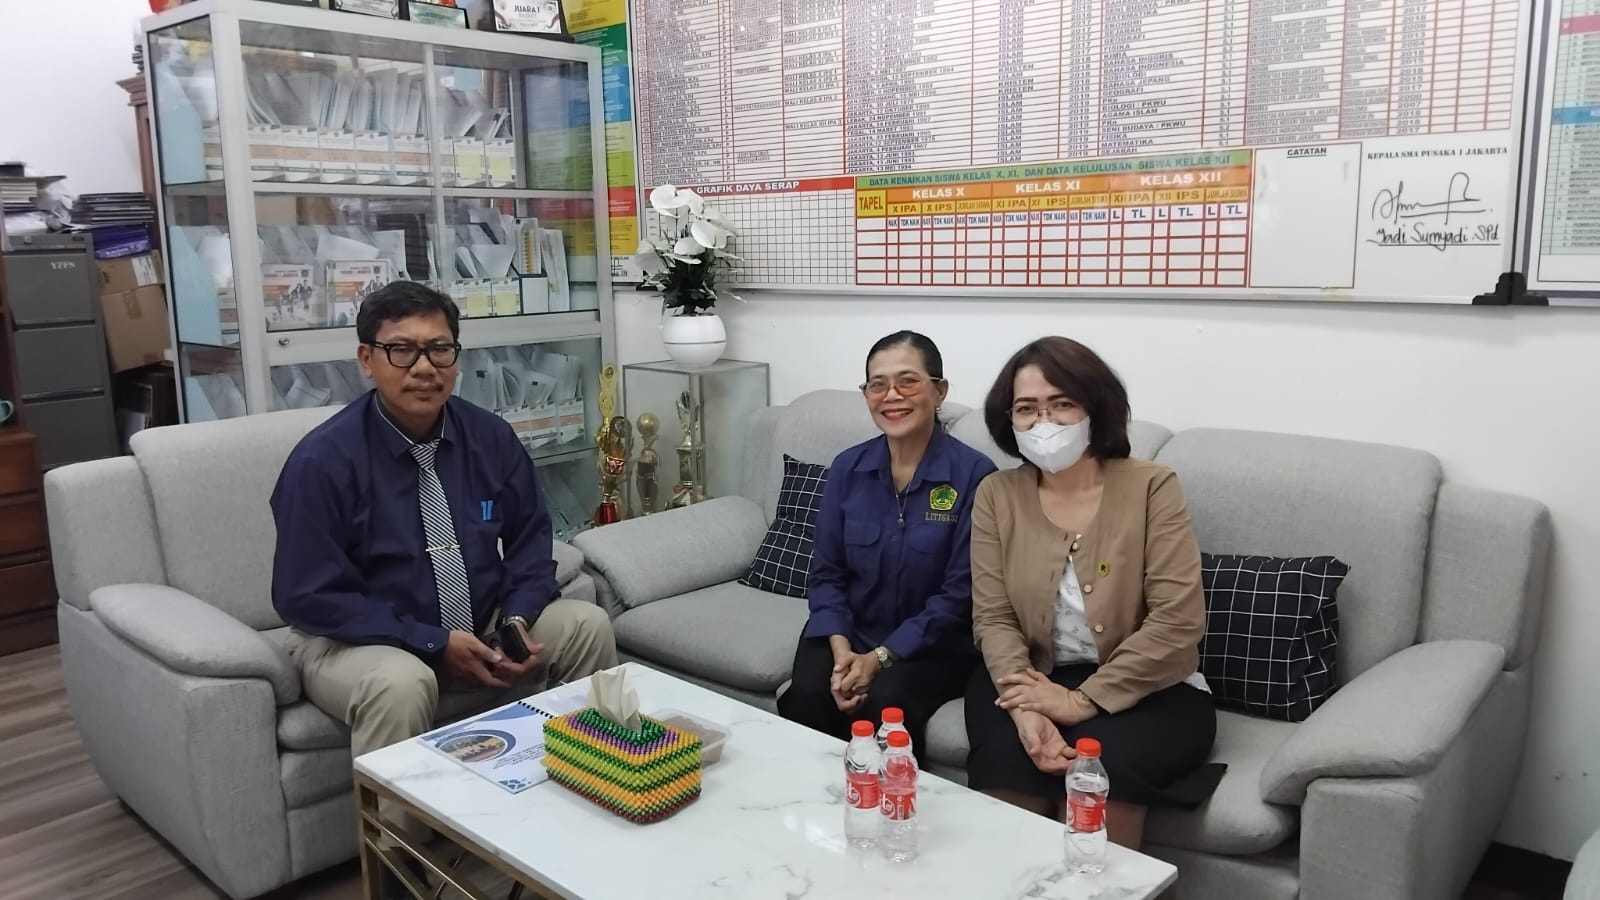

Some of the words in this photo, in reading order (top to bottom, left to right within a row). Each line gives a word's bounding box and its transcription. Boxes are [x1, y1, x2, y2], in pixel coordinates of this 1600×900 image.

[1102, 111, 1130, 119] AGAMA
[1133, 108, 1158, 116] ISLAM
[1101, 139, 1153, 148] MATEMATIKA
[1287, 147, 1327, 157] CATATAN
[1367, 151, 1399, 160] KEPALA
[1421, 150, 1456, 158] PUSAKA
[1465, 147, 1508, 156] JAKARTA
[869, 178, 889, 186] DATA
[890, 176, 932, 185] KENAIKAN
[934, 174, 960, 183] SISWA
[963, 172, 991, 180] KELAS
[1025, 168, 1043, 176] DAN
[1046, 166, 1070, 175] DATA
[1073, 163, 1132, 173] KELULUSAN
[1138, 160, 1172, 169] SISWA
[1175, 157, 1211, 167] KELAS
[1214, 155, 1230, 164] XII
[1140, 173, 1195, 186] KELAS
[1199, 172, 1221, 183] XII
[696, 185, 733, 195] GRAFIK
[736, 183, 761, 192] DAYA
[765, 181, 800, 191] SERAP
[1015, 181, 1061, 193] KELAS
[1065, 180, 1080, 190] XI
[912, 188, 952, 199] KELAS
[956, 187, 965, 196] X
[1129, 193, 1150, 201] IPA
[1176, 190, 1199, 200] IPS
[858, 197, 883, 211] TAPEL
[995, 200, 1005, 208] XI
[1008, 199, 1027, 207] IPA
[1046, 196, 1066, 205] IPS
[892, 205, 898, 213] X
[900, 204, 917, 212] IPA
[934, 203, 952, 211] IPS
[1208, 206, 1215, 216] L
[1226, 205, 1242, 215] TL
[1043, 212, 1053, 220] TDK
[1053, 212, 1066, 221] NAIK
[1082, 211, 1093, 220] TDK
[1093, 210, 1107, 219] NAIK
[1113, 210, 1120, 218] L
[1131, 209, 1146, 218] TL
[1158, 209, 1166, 217] L
[1178, 208, 1193, 217] TL
[909, 218, 920, 226] NAIK
[934, 217, 943, 225] TDK
[968, 216, 977, 224] TDK
[978, 215, 989, 223] NAIK
[1006, 214, 1014, 222] TDK
[1015, 213, 1027, 221] NAIK
[50, 261, 76, 270] YPPN
